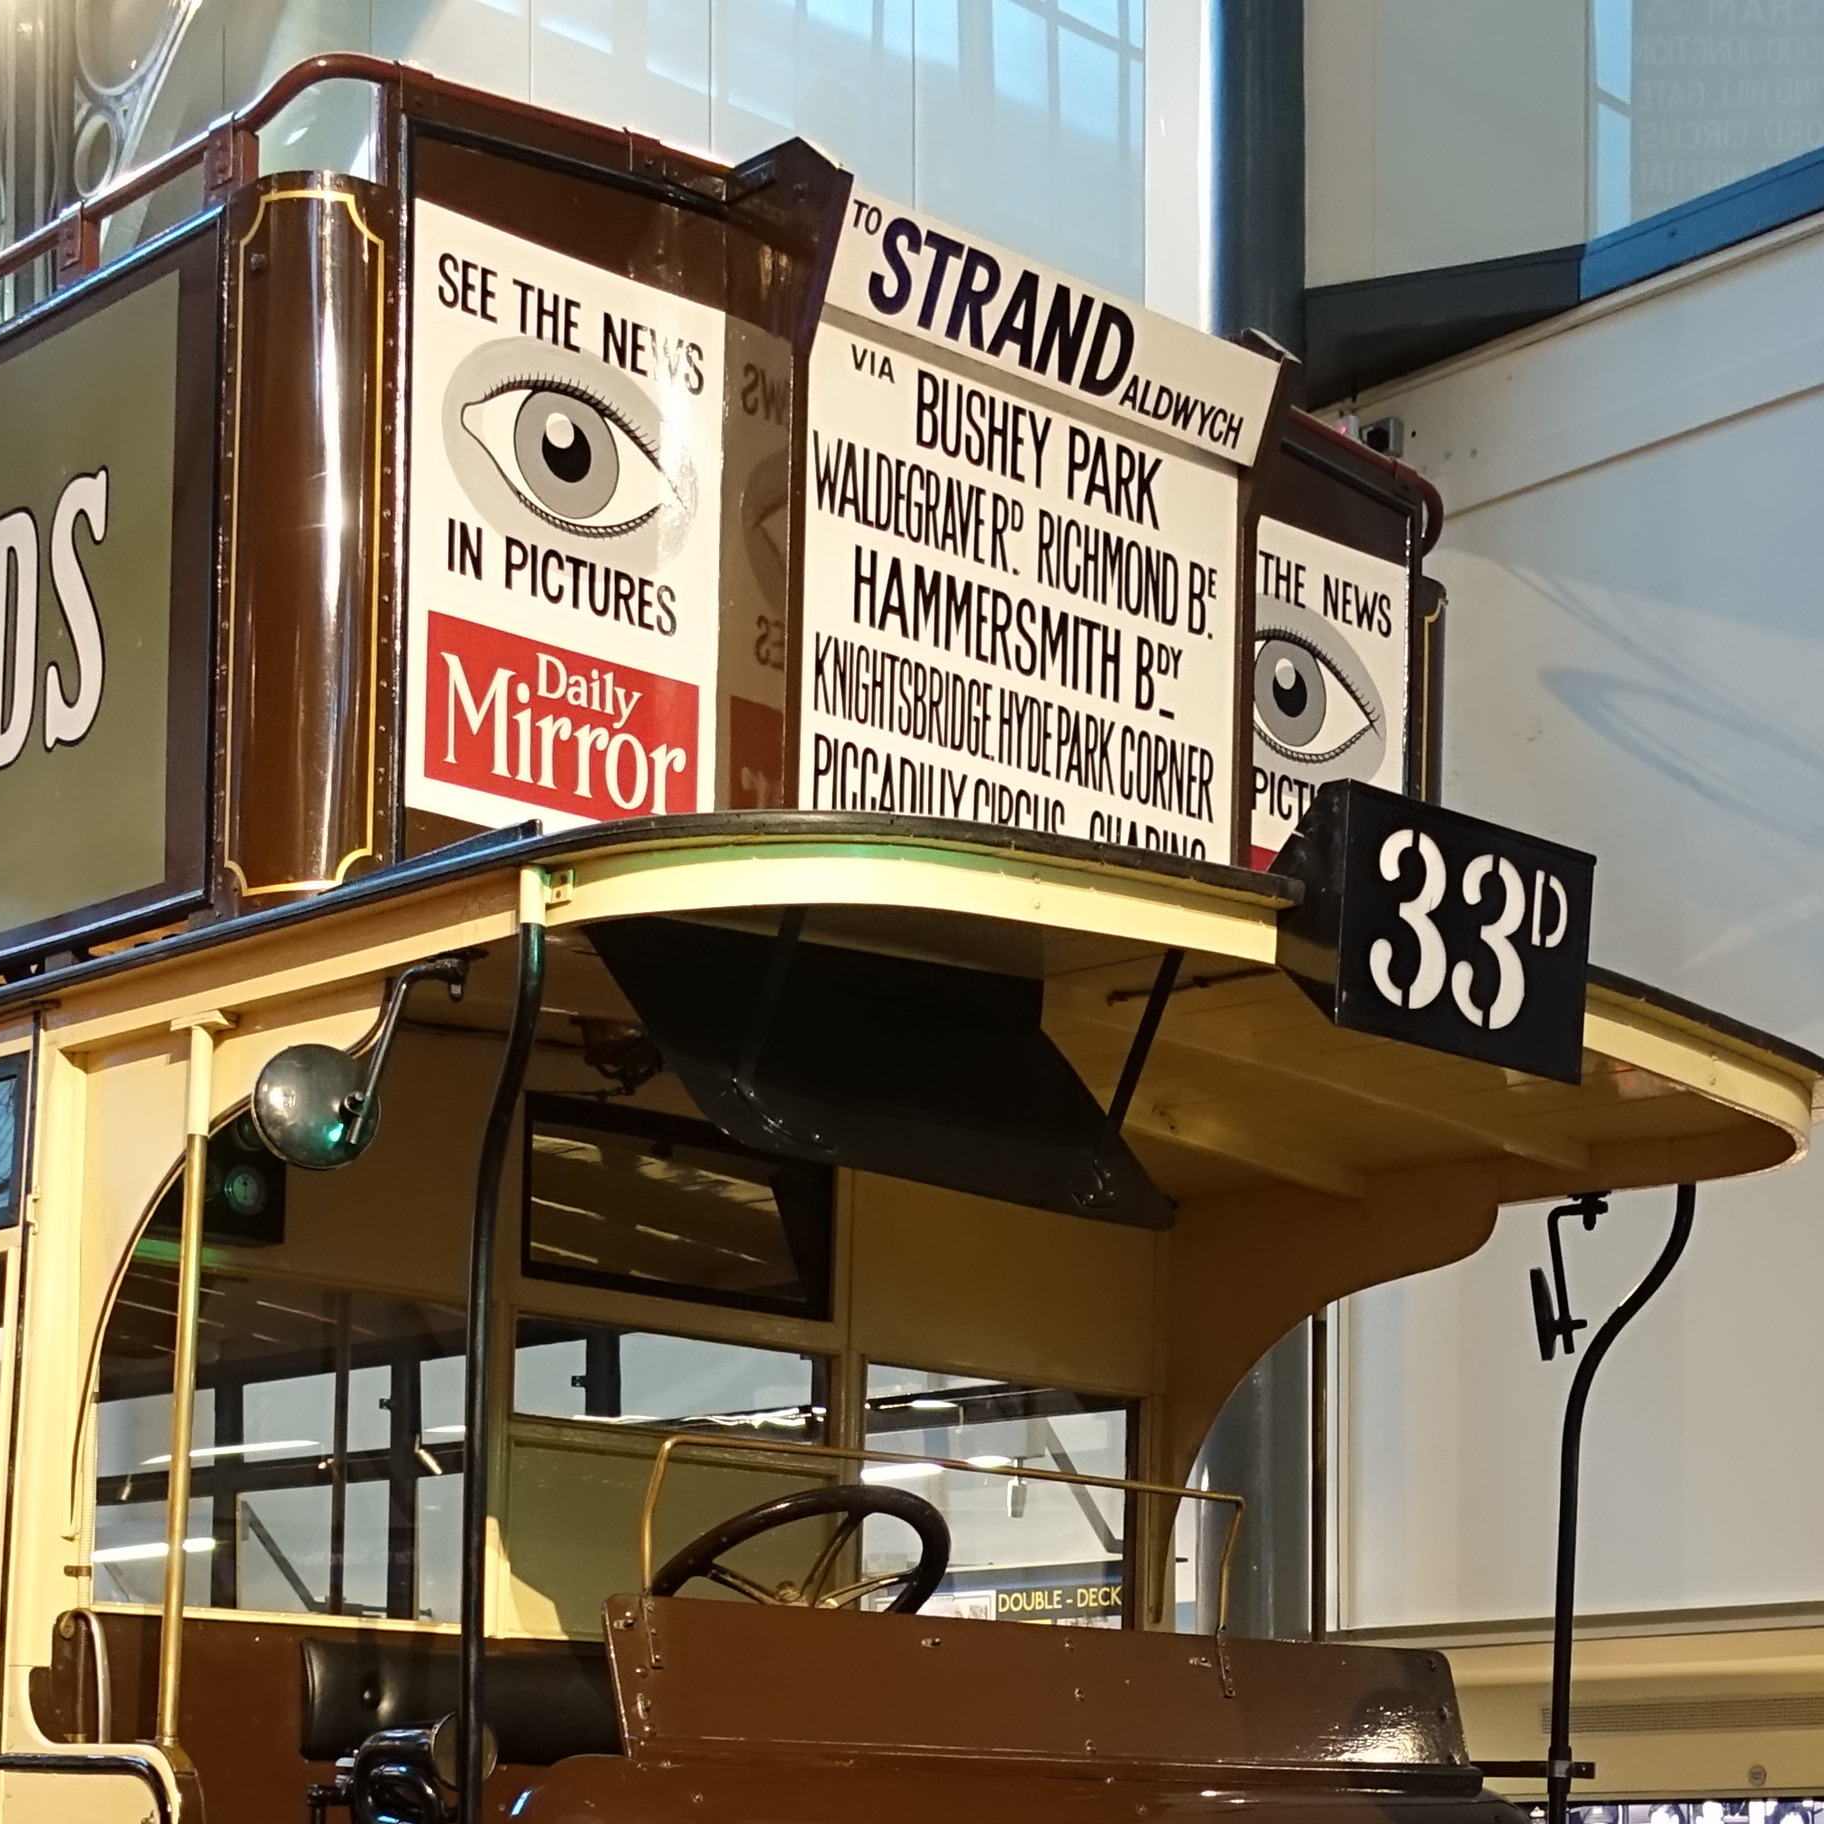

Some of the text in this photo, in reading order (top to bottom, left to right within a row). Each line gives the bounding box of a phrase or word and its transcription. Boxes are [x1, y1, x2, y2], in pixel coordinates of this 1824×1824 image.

[437, 252, 705, 396] SEE THE NEWS
[850, 343, 896, 384] VIA
[853, 199, 1134, 397] TO STRAND
[916, 369, 1163, 531] BUSHEY PARK
[1119, 375, 1244, 450] ALDWYCH
[447, 517, 678, 637] IN PICTURES
[813, 429, 986, 565] WALDEGRAVE
[1038, 508, 1176, 627] RICHMOND
[1259, 550, 1393, 639] THE NEWS
[536, 652, 643, 729] Daily
[852, 545, 1121, 704] HAMMERSMITH
[440, 650, 687, 816] Mirror
[999, 688, 1053, 778] HYDE
[1055, 706, 1115, 796] PARK
[1120, 724, 1215, 824] CORNER
[998, 1590, 1062, 1613] DOUBLE
[1077, 1586, 1122, 1607] DECK
